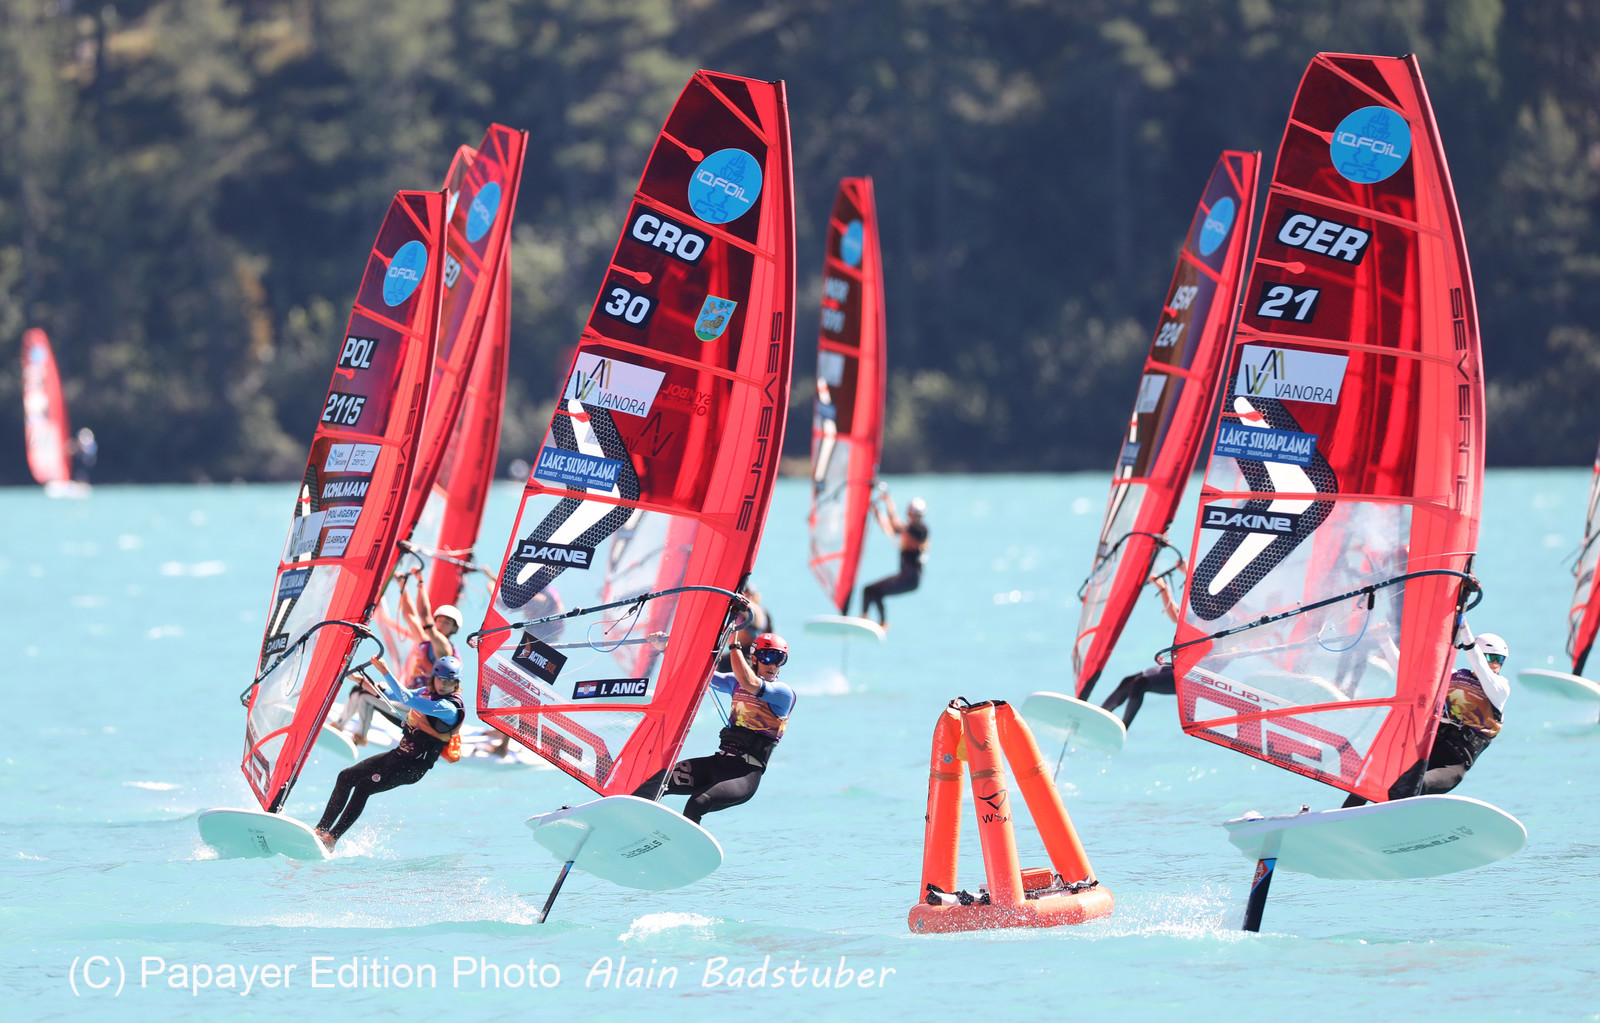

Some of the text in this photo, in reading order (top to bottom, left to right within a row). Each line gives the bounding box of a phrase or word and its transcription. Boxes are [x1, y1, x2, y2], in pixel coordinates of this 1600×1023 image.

[632, 213, 705, 261] CRO
[1278, 213, 1369, 262] GER
[604, 287, 650, 324] 30
[1257, 285, 1319, 321] 21
[1155, 323, 1185, 348] 224
[339, 337, 374, 368] POL
[597, 391, 647, 416] VANORA
[1274, 382, 1333, 403] VANORA
[1449, 287, 1472, 516] SEVERNE
[322, 394, 366, 425] 2115
[736, 311, 783, 532] SEVERNE
[1218, 427, 1311, 455] LAKE SILVAPLANA
[540, 451, 616, 481] LAKE SILVAPLANA
[321, 481, 370, 499] KOHLMAN
[600, 679, 646, 695] I. ANIĆ
